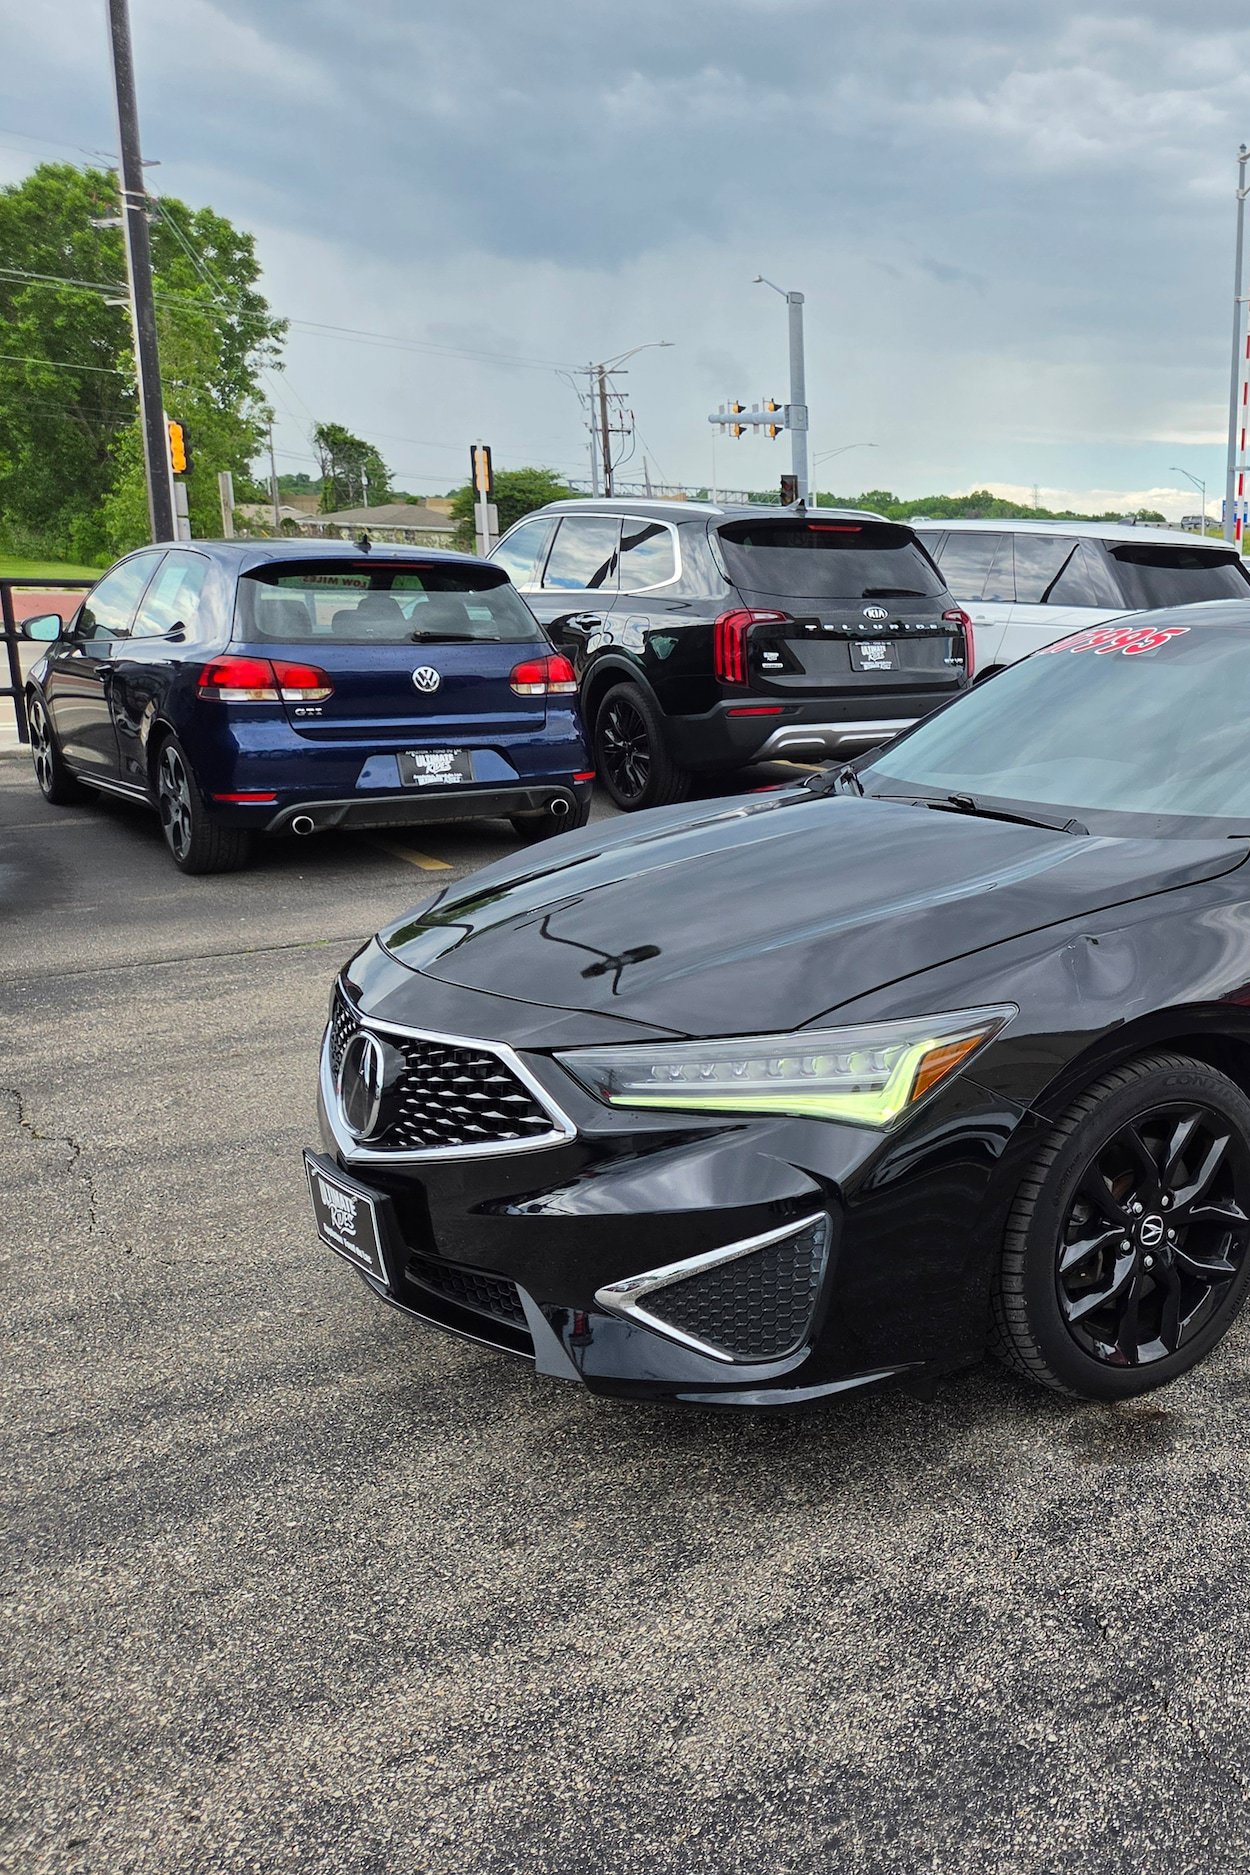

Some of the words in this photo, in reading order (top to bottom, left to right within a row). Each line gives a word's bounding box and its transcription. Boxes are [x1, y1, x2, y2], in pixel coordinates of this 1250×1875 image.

[866, 608, 886, 619] KIA
[295, 708, 322, 716] GTI
[415, 753, 455, 767] ULTIMATE
[318, 1176, 357, 1217] ULTIMATE
